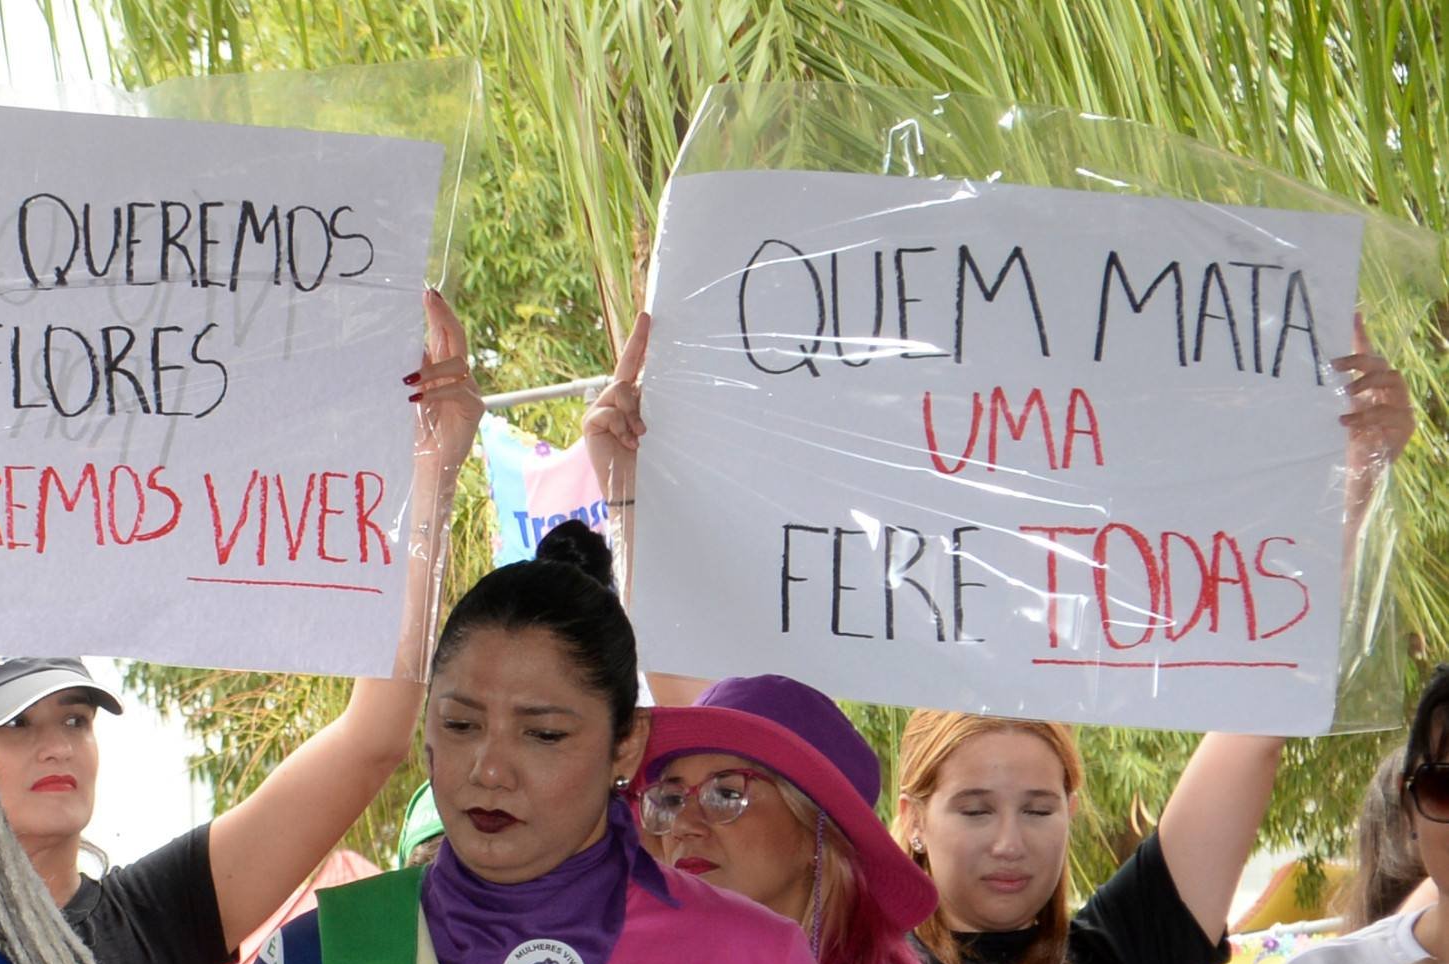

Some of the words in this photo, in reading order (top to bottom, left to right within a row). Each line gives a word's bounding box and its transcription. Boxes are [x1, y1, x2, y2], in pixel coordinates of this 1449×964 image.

[18, 193, 374, 293] QUEREMOS
[738, 238, 1050, 378] QUEM
[1094, 250, 1324, 386] MATA
[923, 386, 1105, 475] UMA
[203, 468, 392, 567] VIVER
[781, 524, 987, 643] FERE
[1020, 522, 1311, 650] TODAS
[515, 943, 562, 959] MULHERES
